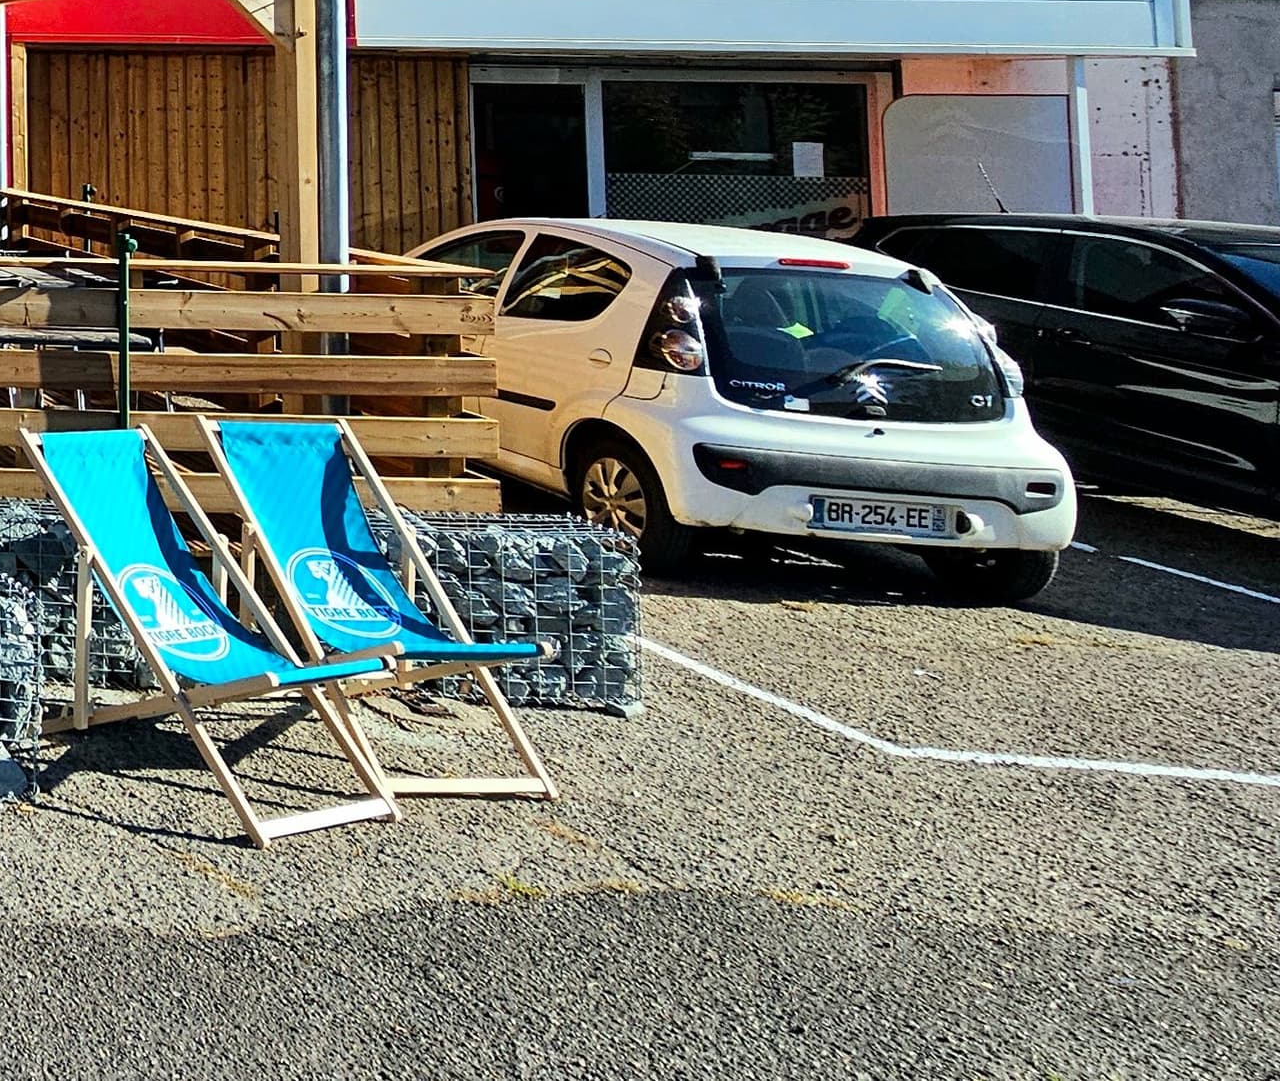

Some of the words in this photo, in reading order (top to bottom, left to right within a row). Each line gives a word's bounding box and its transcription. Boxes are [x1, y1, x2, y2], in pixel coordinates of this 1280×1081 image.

[971, 394, 993, 407] C1
[827, 501, 930, 529] BR-254-EE
[311, 607, 356, 618] TIGRE
[148, 629, 187, 643] TIGRE
